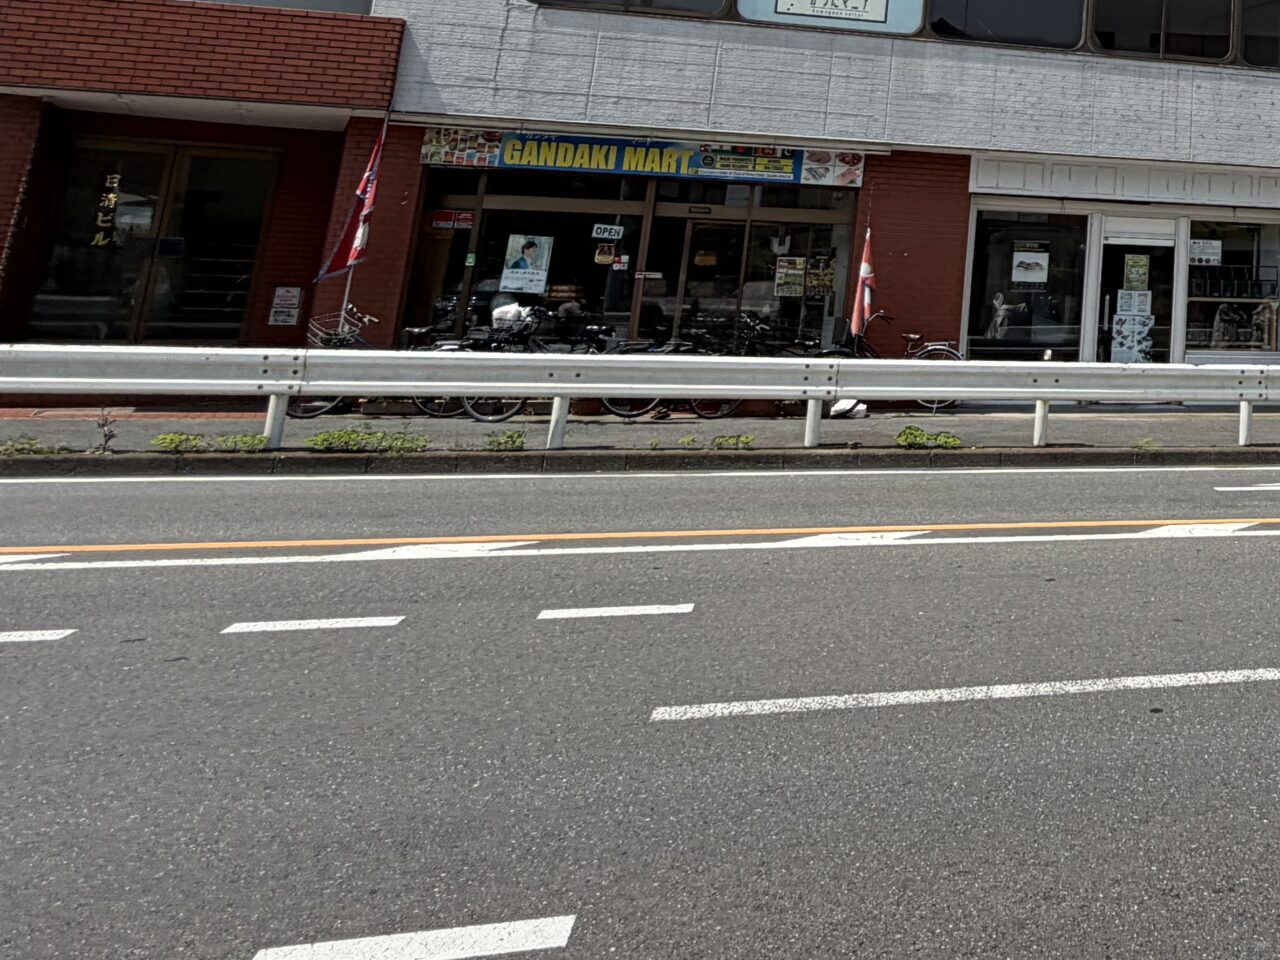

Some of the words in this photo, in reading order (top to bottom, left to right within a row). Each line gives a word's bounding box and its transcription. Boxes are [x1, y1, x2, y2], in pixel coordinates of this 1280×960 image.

[503, 139, 618, 170] GANDAKI
[622, 146, 694, 175] MART
[595, 226, 621, 238] OPEN
